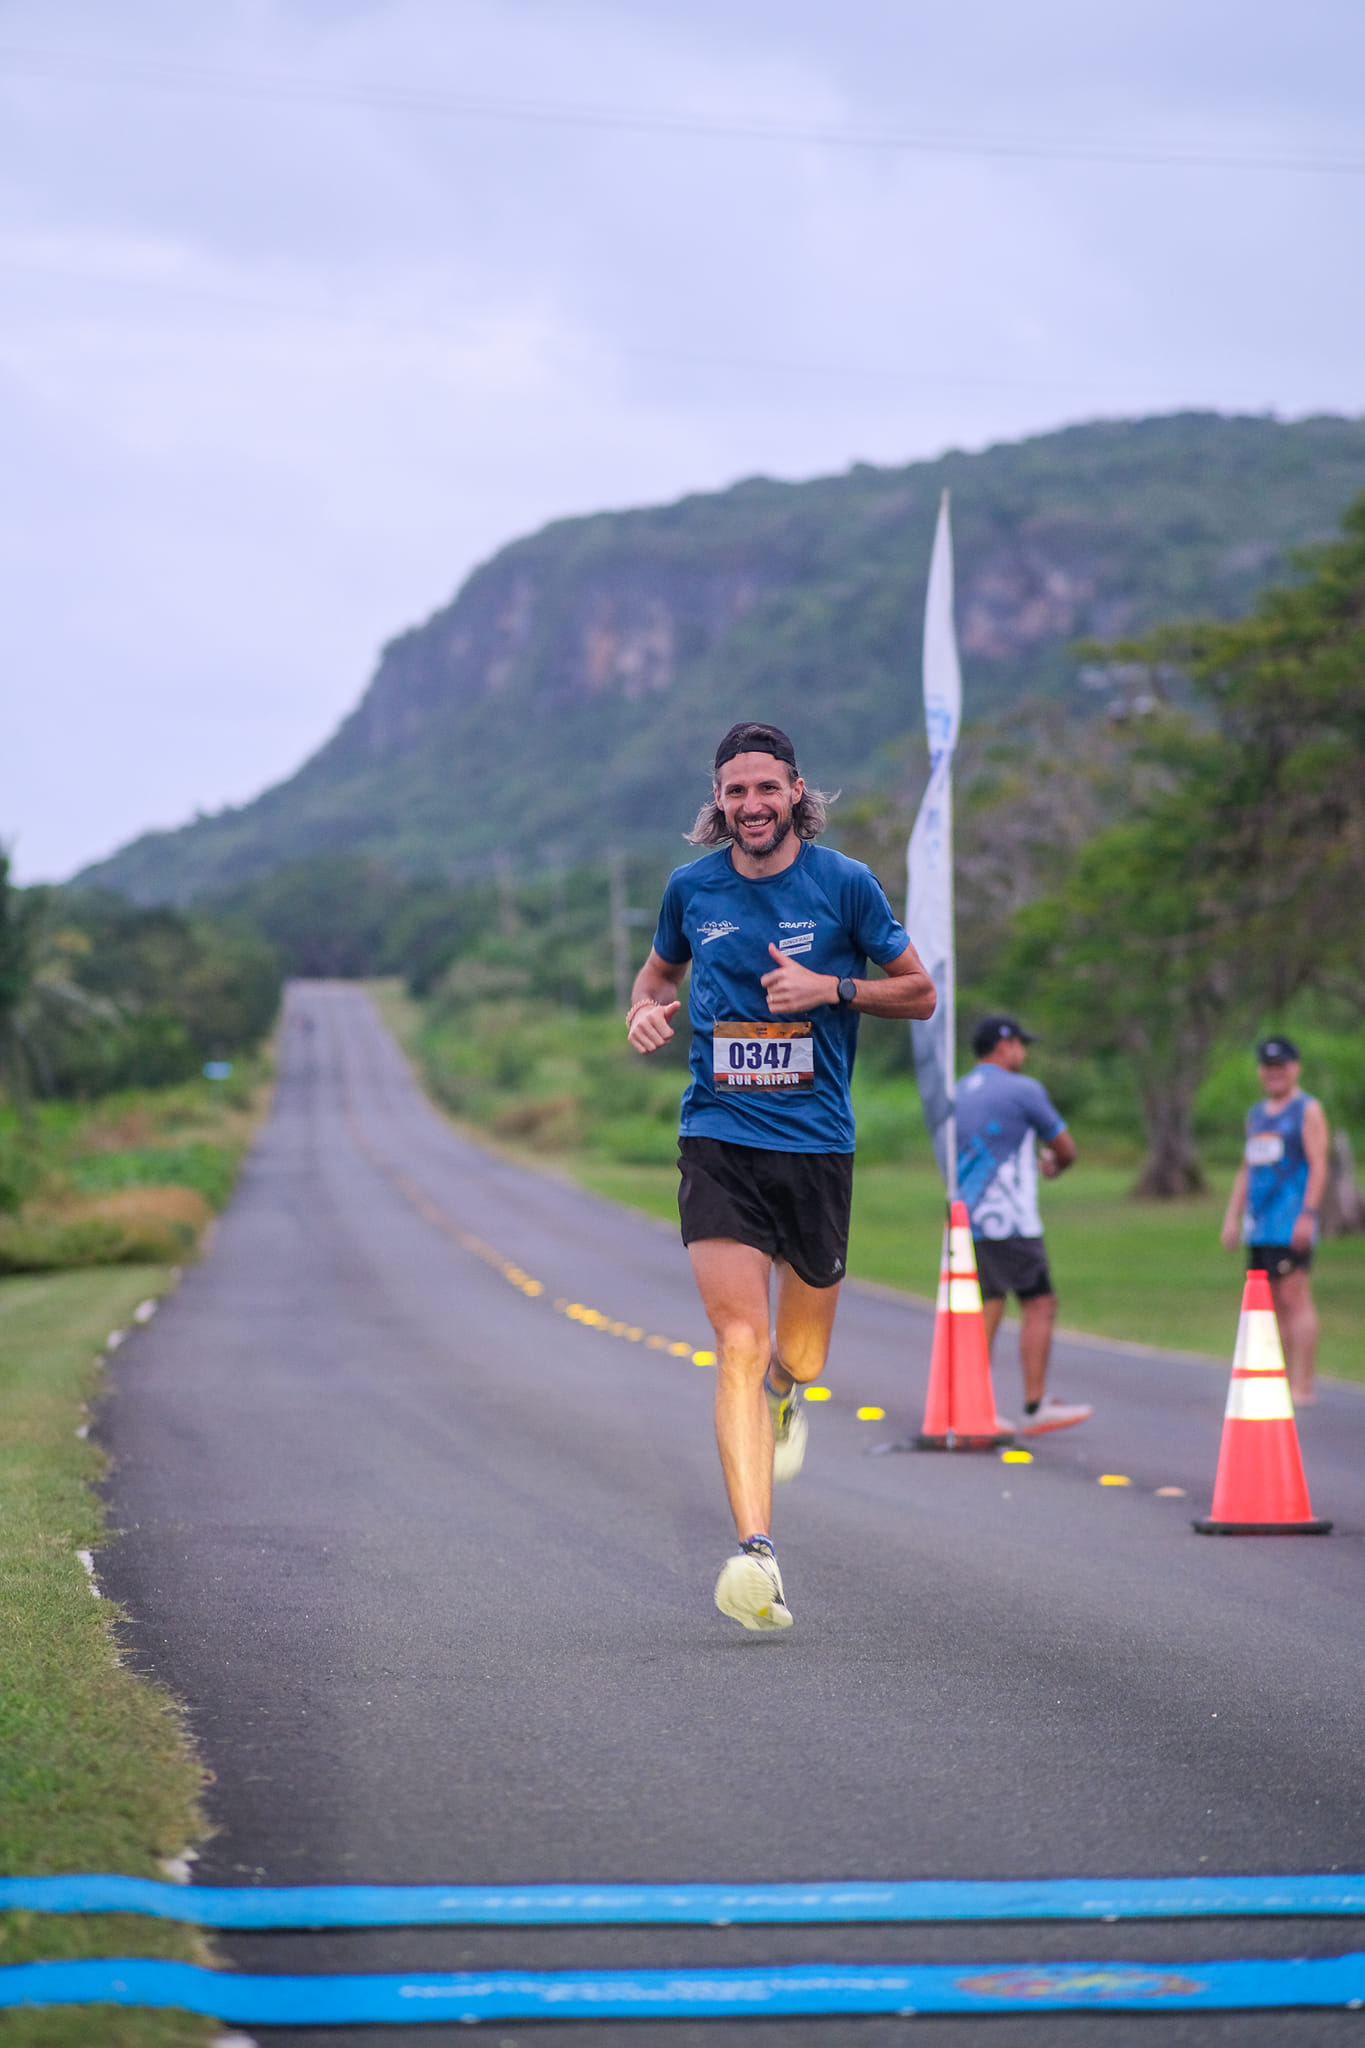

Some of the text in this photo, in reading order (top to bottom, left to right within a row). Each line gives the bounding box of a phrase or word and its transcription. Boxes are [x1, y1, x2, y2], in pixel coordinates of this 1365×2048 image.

[778, 921, 808, 929] CRAFT
[729, 1042, 792, 1069] 0347
[728, 1073, 799, 1086] RUN SAIPAN
